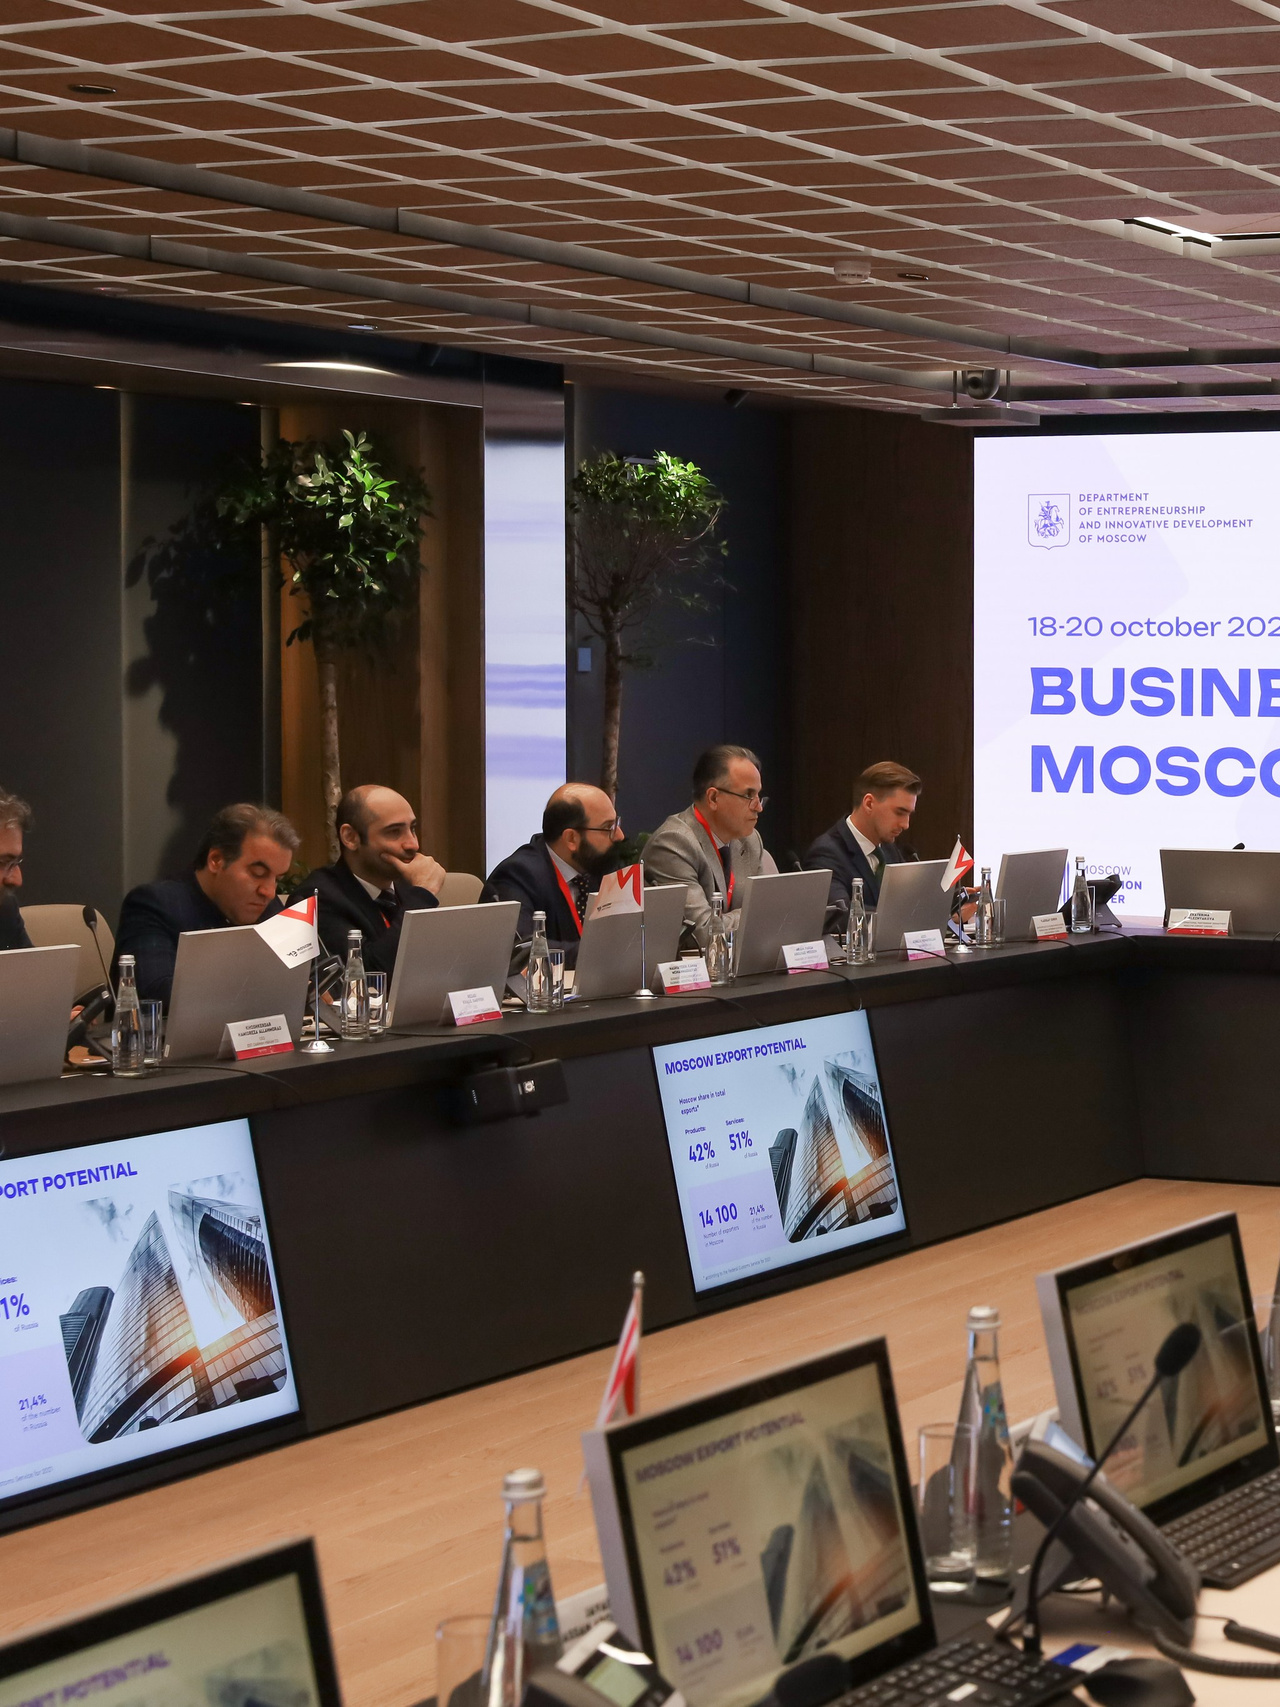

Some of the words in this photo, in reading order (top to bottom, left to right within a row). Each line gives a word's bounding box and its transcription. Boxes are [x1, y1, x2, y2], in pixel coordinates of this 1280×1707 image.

[1079, 493, 1149, 502] DEPARTMENT
[1079, 507, 1092, 515] OF
[1097, 506, 1205, 515] ENTREPRENEURSHIP
[1079, 521, 1101, 529] AND
[1106, 520, 1168, 528] INNOVATIVE
[1174, 519, 1253, 528] DEVELOPMENT
[1079, 535, 1092, 543] OF
[1028, 617, 1103, 636] 18-20
[1111, 617, 1221, 636] october
[665, 1052, 714, 1075] MOSCOW
[716, 1045, 753, 1066] EXPORT
[754, 1037, 807, 1060] POTENTIAL
[728, 1130, 753, 1151] 51%
[689, 1141, 715, 1163] 42%
[42, 1161, 138, 1192] POTENTIAL
[699, 1209, 714, 1228] 14
[715, 1202, 738, 1224] 100
[0, 1292, 31, 1320] 1%
[18, 1393, 48, 1411] 21,4%
